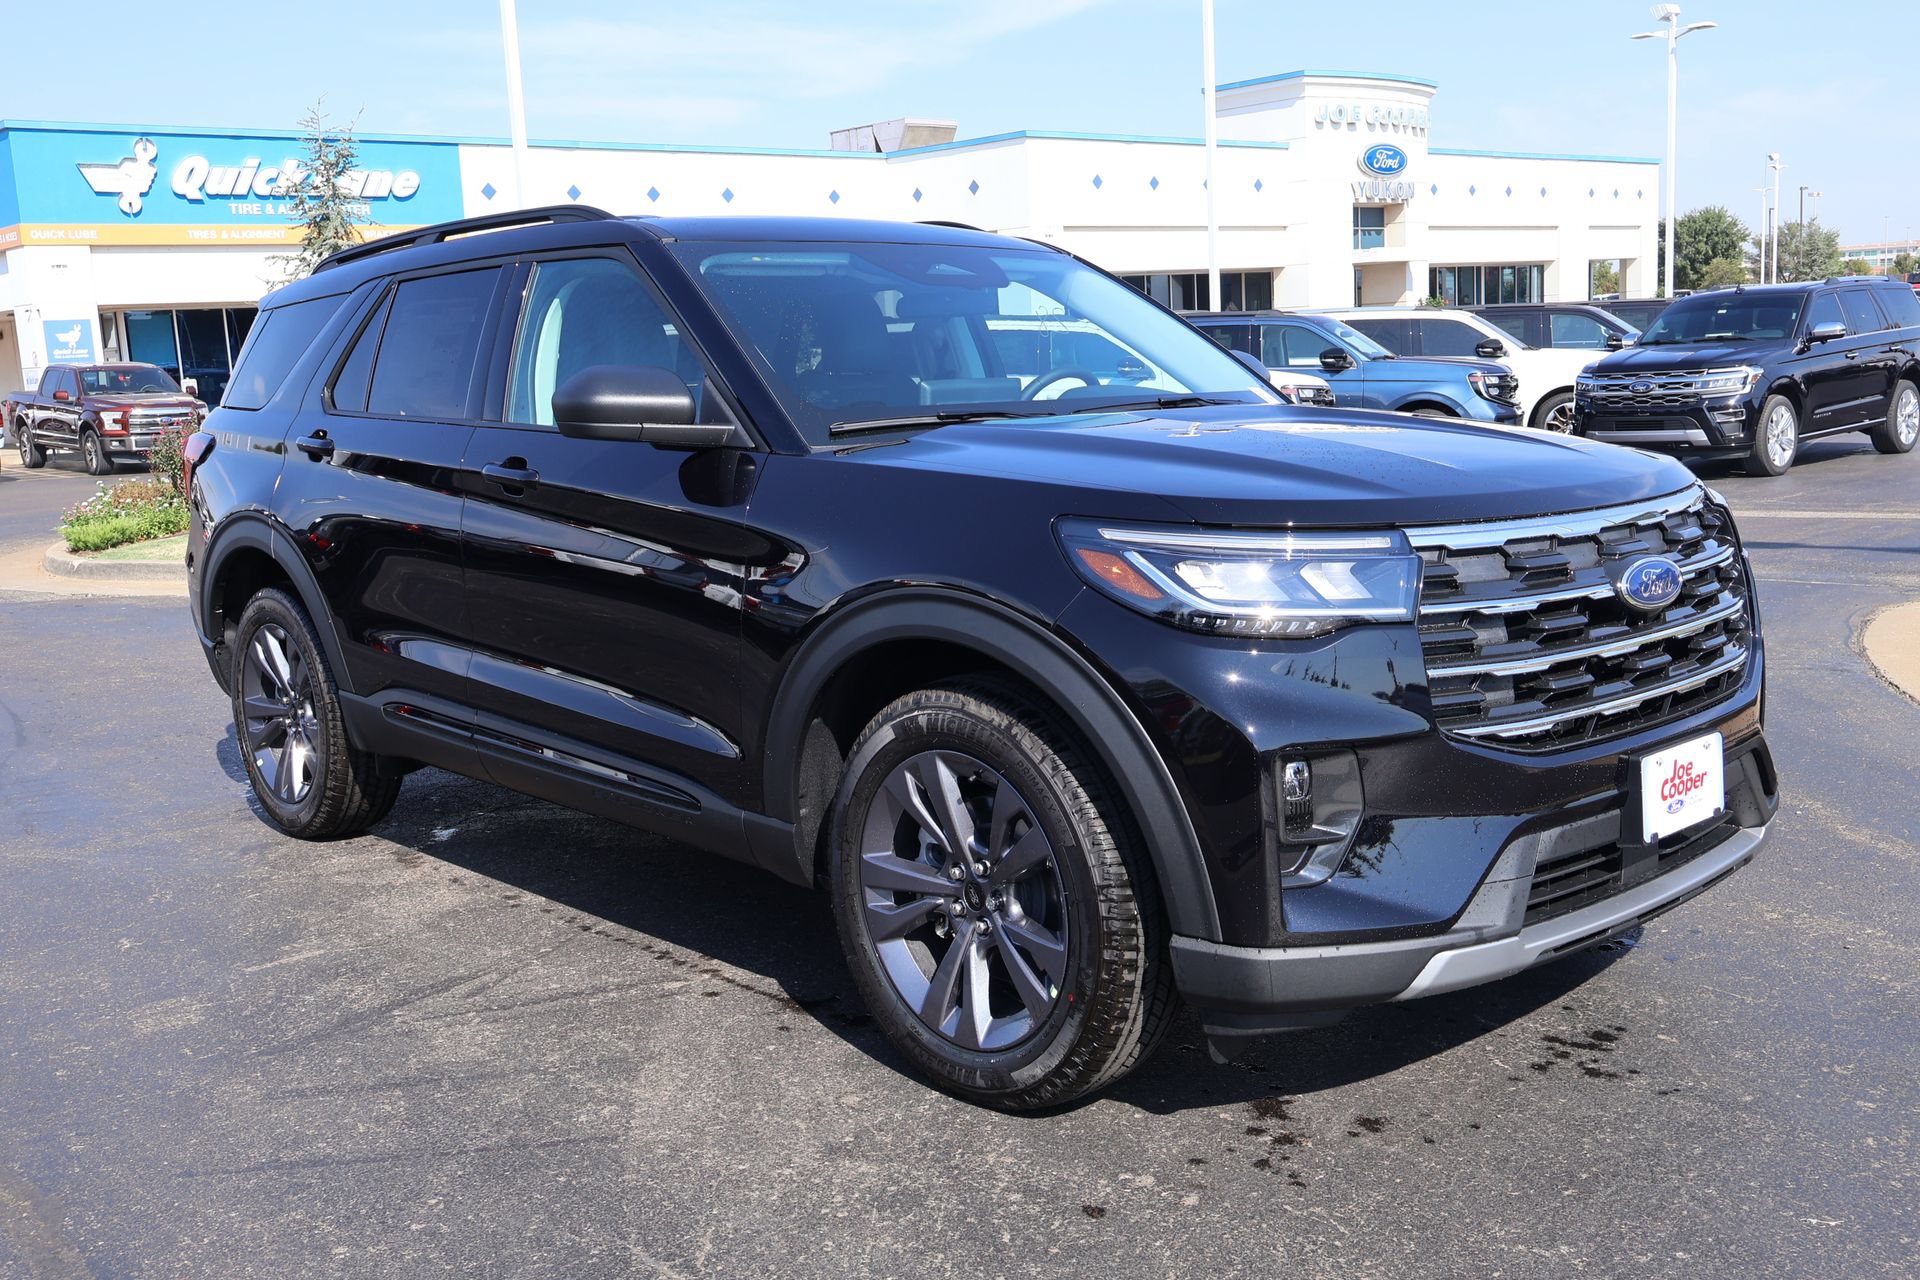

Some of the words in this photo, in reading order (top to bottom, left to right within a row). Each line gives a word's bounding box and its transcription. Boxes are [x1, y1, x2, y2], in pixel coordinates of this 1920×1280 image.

[1315, 104, 1361, 126] JOE
[1373, 149, 1400, 169] Ford
[170, 154, 313, 202] Quick
[1353, 180, 1415, 200] YUKON
[228, 202, 262, 216] TIRE
[264, 202, 275, 215] &
[30, 229, 65, 239] QUICK
[67, 229, 98, 239] LUBE
[187, 229, 217, 239] TIRES
[221, 230, 229, 239] &
[230, 229, 286, 239] ALIGNMENT
[1641, 567, 1674, 597] Ford
[1669, 759, 1694, 783] Joe
[1016, 760, 1058, 815] PRIMACY
[1660, 770, 1708, 802] Cooper
